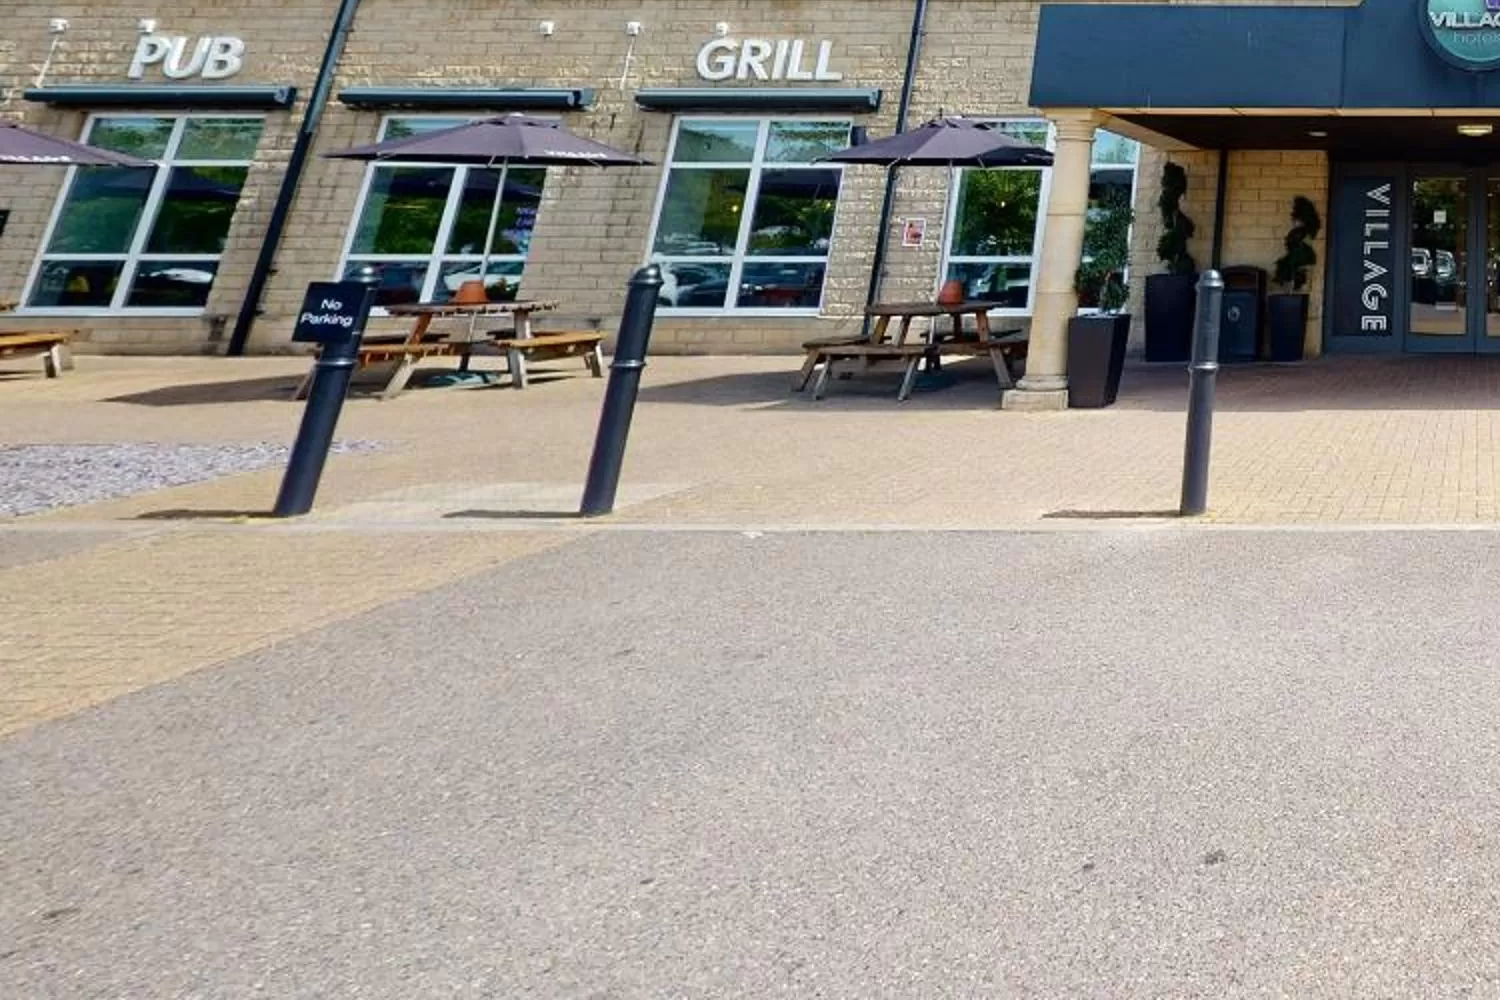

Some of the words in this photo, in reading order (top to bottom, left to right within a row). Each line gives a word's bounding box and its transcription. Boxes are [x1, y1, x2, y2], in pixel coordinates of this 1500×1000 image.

[128, 35, 245, 79] PUB
[696, 38, 843, 81] GRILL
[1361, 183, 1391, 331] VILLAGE
[301, 312, 353, 328] Parking
[321, 298, 342, 311] No
